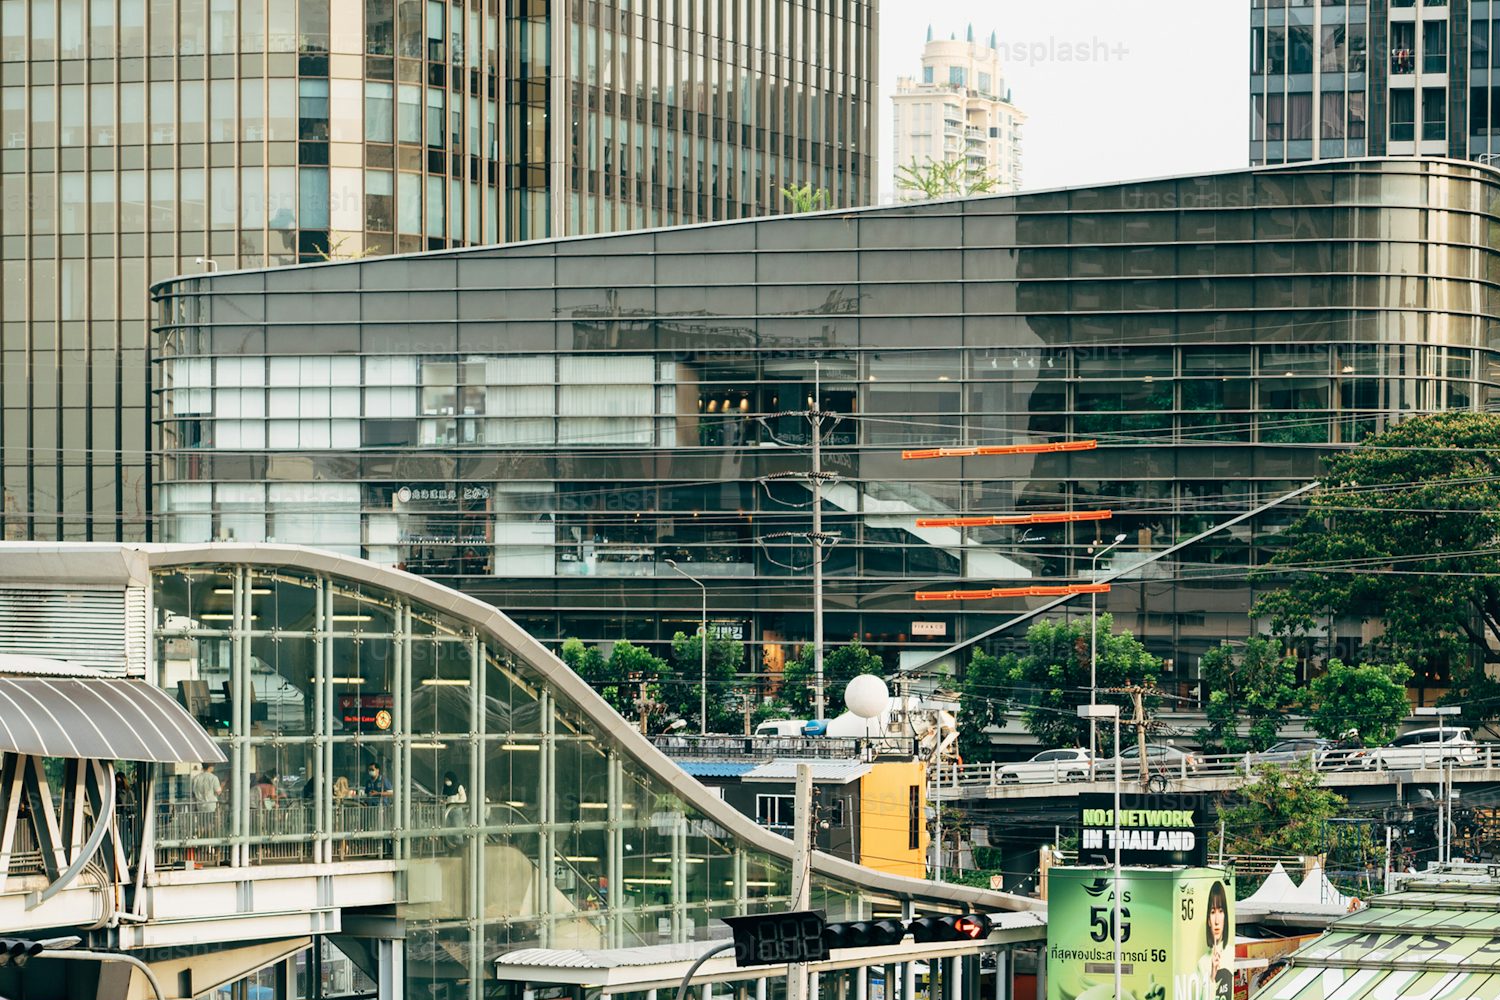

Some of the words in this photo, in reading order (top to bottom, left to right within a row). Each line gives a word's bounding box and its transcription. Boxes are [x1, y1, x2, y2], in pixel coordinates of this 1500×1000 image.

[1083, 809, 1114, 826] NO.1
[1117, 810, 1195, 828] NETWORK
[1083, 829, 1103, 849] IN
[1106, 830, 1195, 851] THAILAND
[1181, 899, 1194, 920] 5G
[1090, 905, 1131, 943] 5G
[1151, 950, 1166, 962] 5G
